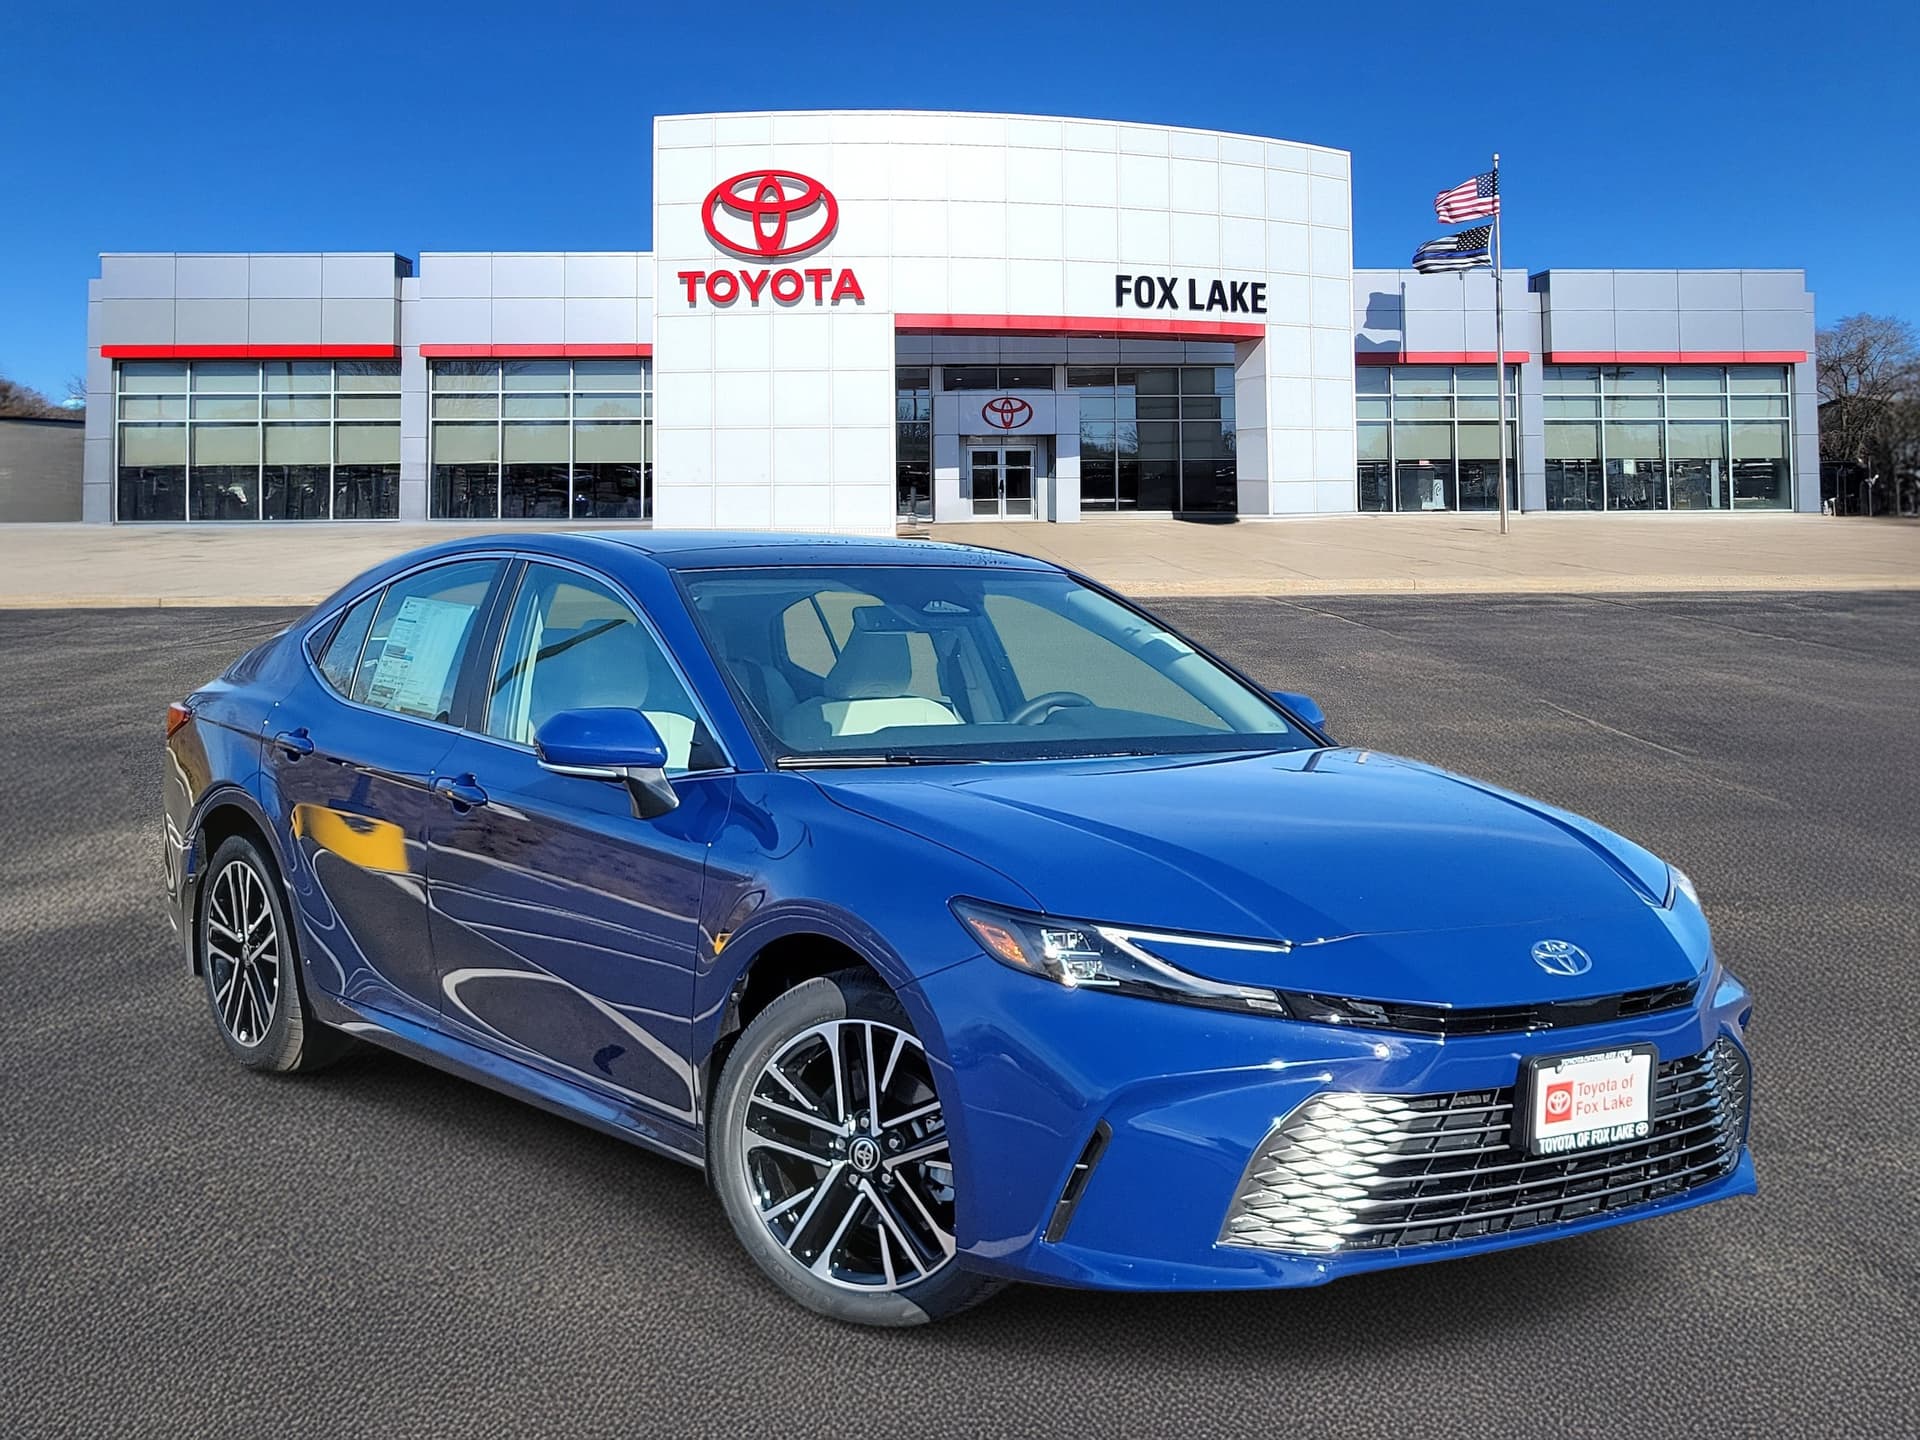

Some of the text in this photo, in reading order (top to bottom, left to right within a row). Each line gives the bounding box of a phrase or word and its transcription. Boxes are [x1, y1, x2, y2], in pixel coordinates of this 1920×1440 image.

[677, 268, 866, 304] TOYOTA
[1115, 274, 1268, 314] FOX LAKE
[1577, 1073, 1635, 1098] Toyota of
[1576, 1094, 1633, 1116] Fox Lake
[1539, 1123, 1635, 1154] TOYOTA OF FOX LAKE
